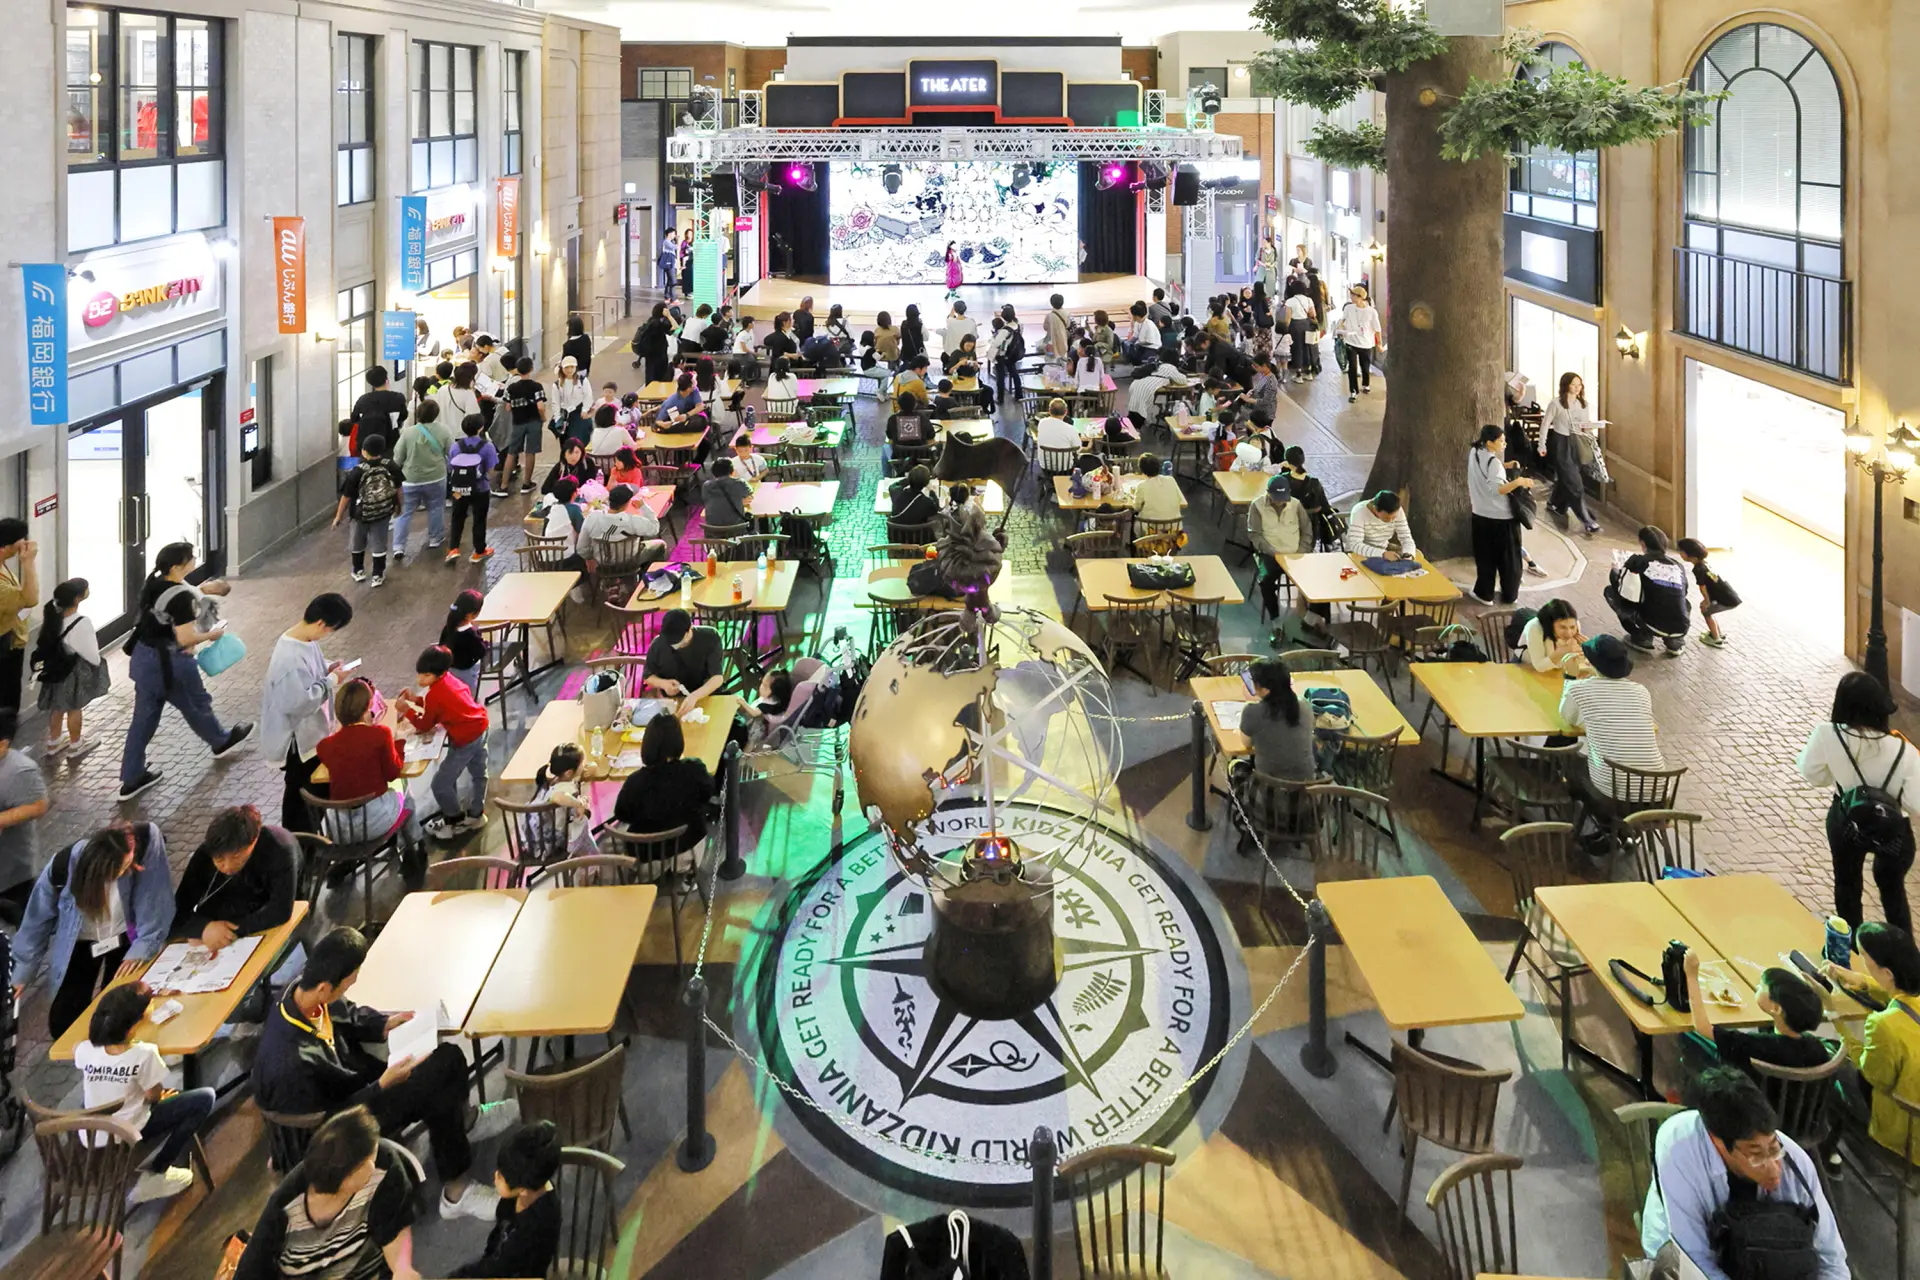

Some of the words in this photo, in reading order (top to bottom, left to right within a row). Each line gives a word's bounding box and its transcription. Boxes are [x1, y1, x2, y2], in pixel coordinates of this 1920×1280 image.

[920, 77, 987, 92] THEATER
[281, 228, 297, 266] au
[407, 226, 422, 284] 福岡銀行
[282, 268, 296, 326] じぶん銀行
[31, 315, 55, 413] 福岡銀行
[836, 877, 854, 891] A
[1127, 873, 1165, 905] GET
[805, 891, 842, 930] FOR
[1155, 910, 1194, 980] READY
[792, 933, 818, 1009] READY
[1168, 986, 1194, 1033] FOR
[795, 1016, 828, 1059] GET
[1159, 1036, 1181, 1055] A
[817, 1058, 961, 1162] KIDZANIA
[1084, 1058, 1172, 1137] BETTER
[971, 1125, 1086, 1162] WRLD
